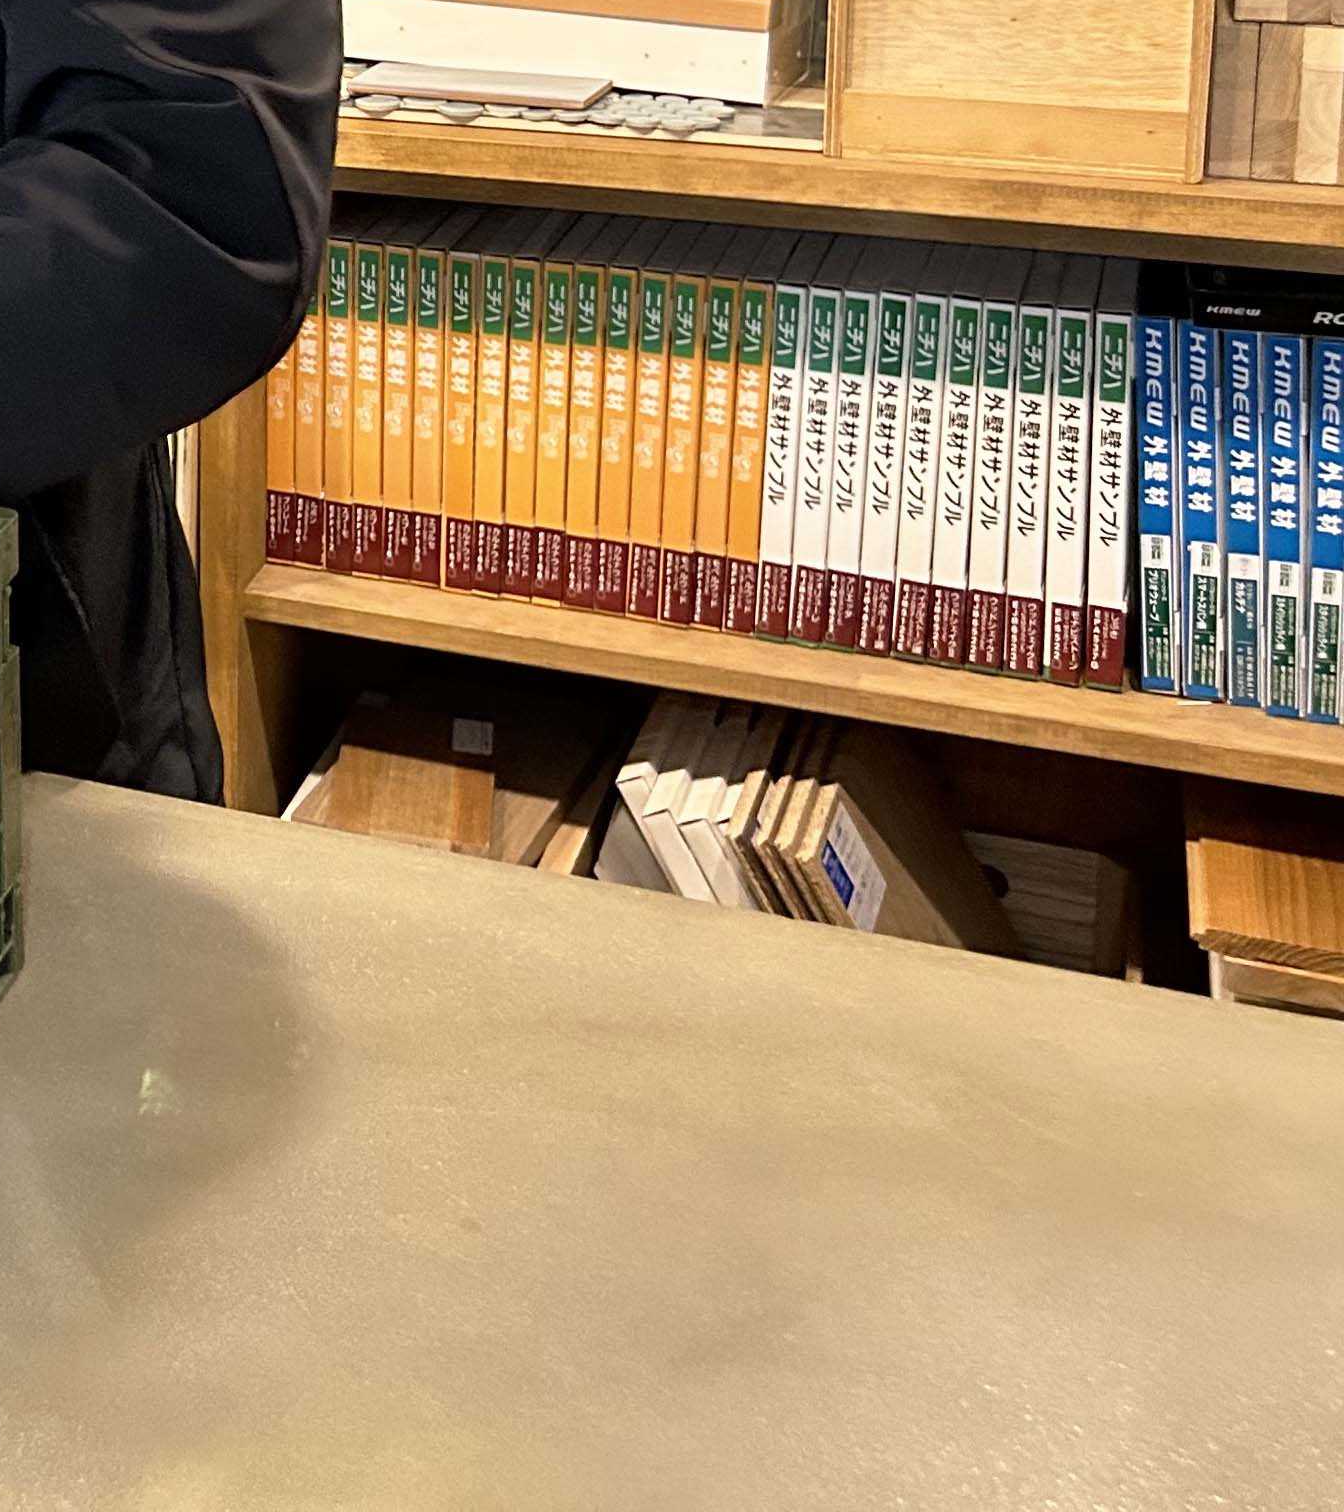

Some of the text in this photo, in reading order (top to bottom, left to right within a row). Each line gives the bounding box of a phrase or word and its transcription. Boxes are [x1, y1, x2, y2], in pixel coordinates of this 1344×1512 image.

[330, 258, 345, 306] ニチハ
[360, 261, 376, 309] ニチハ
[390, 265, 405, 312] ニチハ
[420, 268, 436, 315] ニチハ
[454, 272, 469, 321] ニチハ
[485, 273, 502, 322] ニチハ
[514, 280, 531, 328] ニチハ
[548, 283, 564, 332] ニチハ
[578, 283, 595, 332] ニチハ
[610, 287, 627, 336] ニチハ
[644, 290, 661, 340] ニチハ
[675, 295, 693, 344] ニチハ
[711, 299, 729, 349] ニチハ
[744, 302, 761, 352] ニチハ
[768, 304, 795, 505] ニチハ 外壁材サンプル
[805, 308, 831, 510] ニチハ 外壁材サンプル
[836, 310, 864, 513] ニチハ 外壁材サンプル
[872, 311, 901, 515] ニチハ 外壁材サンプル
[907, 315, 935, 520] ニチハ 外壁材サンプル
[944, 320, 973, 526] ニチハ 外壁材サンプル
[981, 323, 1006, 530] ニチハ 外壁材サンプル
[1017, 328, 1042, 536] ニチハ 外壁材サンプル
[1057, 331, 1081, 541] ニチハ 外壁材サンプル
[1099, 335, 1123, 547] ニチハ 外壁材サンプル
[1144, 436, 1168, 507] 外壁材
[1187, 440, 1212, 512] 外壁材
[1230, 450, 1256, 522] 外壁材
[1271, 456, 1296, 529] 外壁材
[1316, 462, 1343, 535] 外壁材
